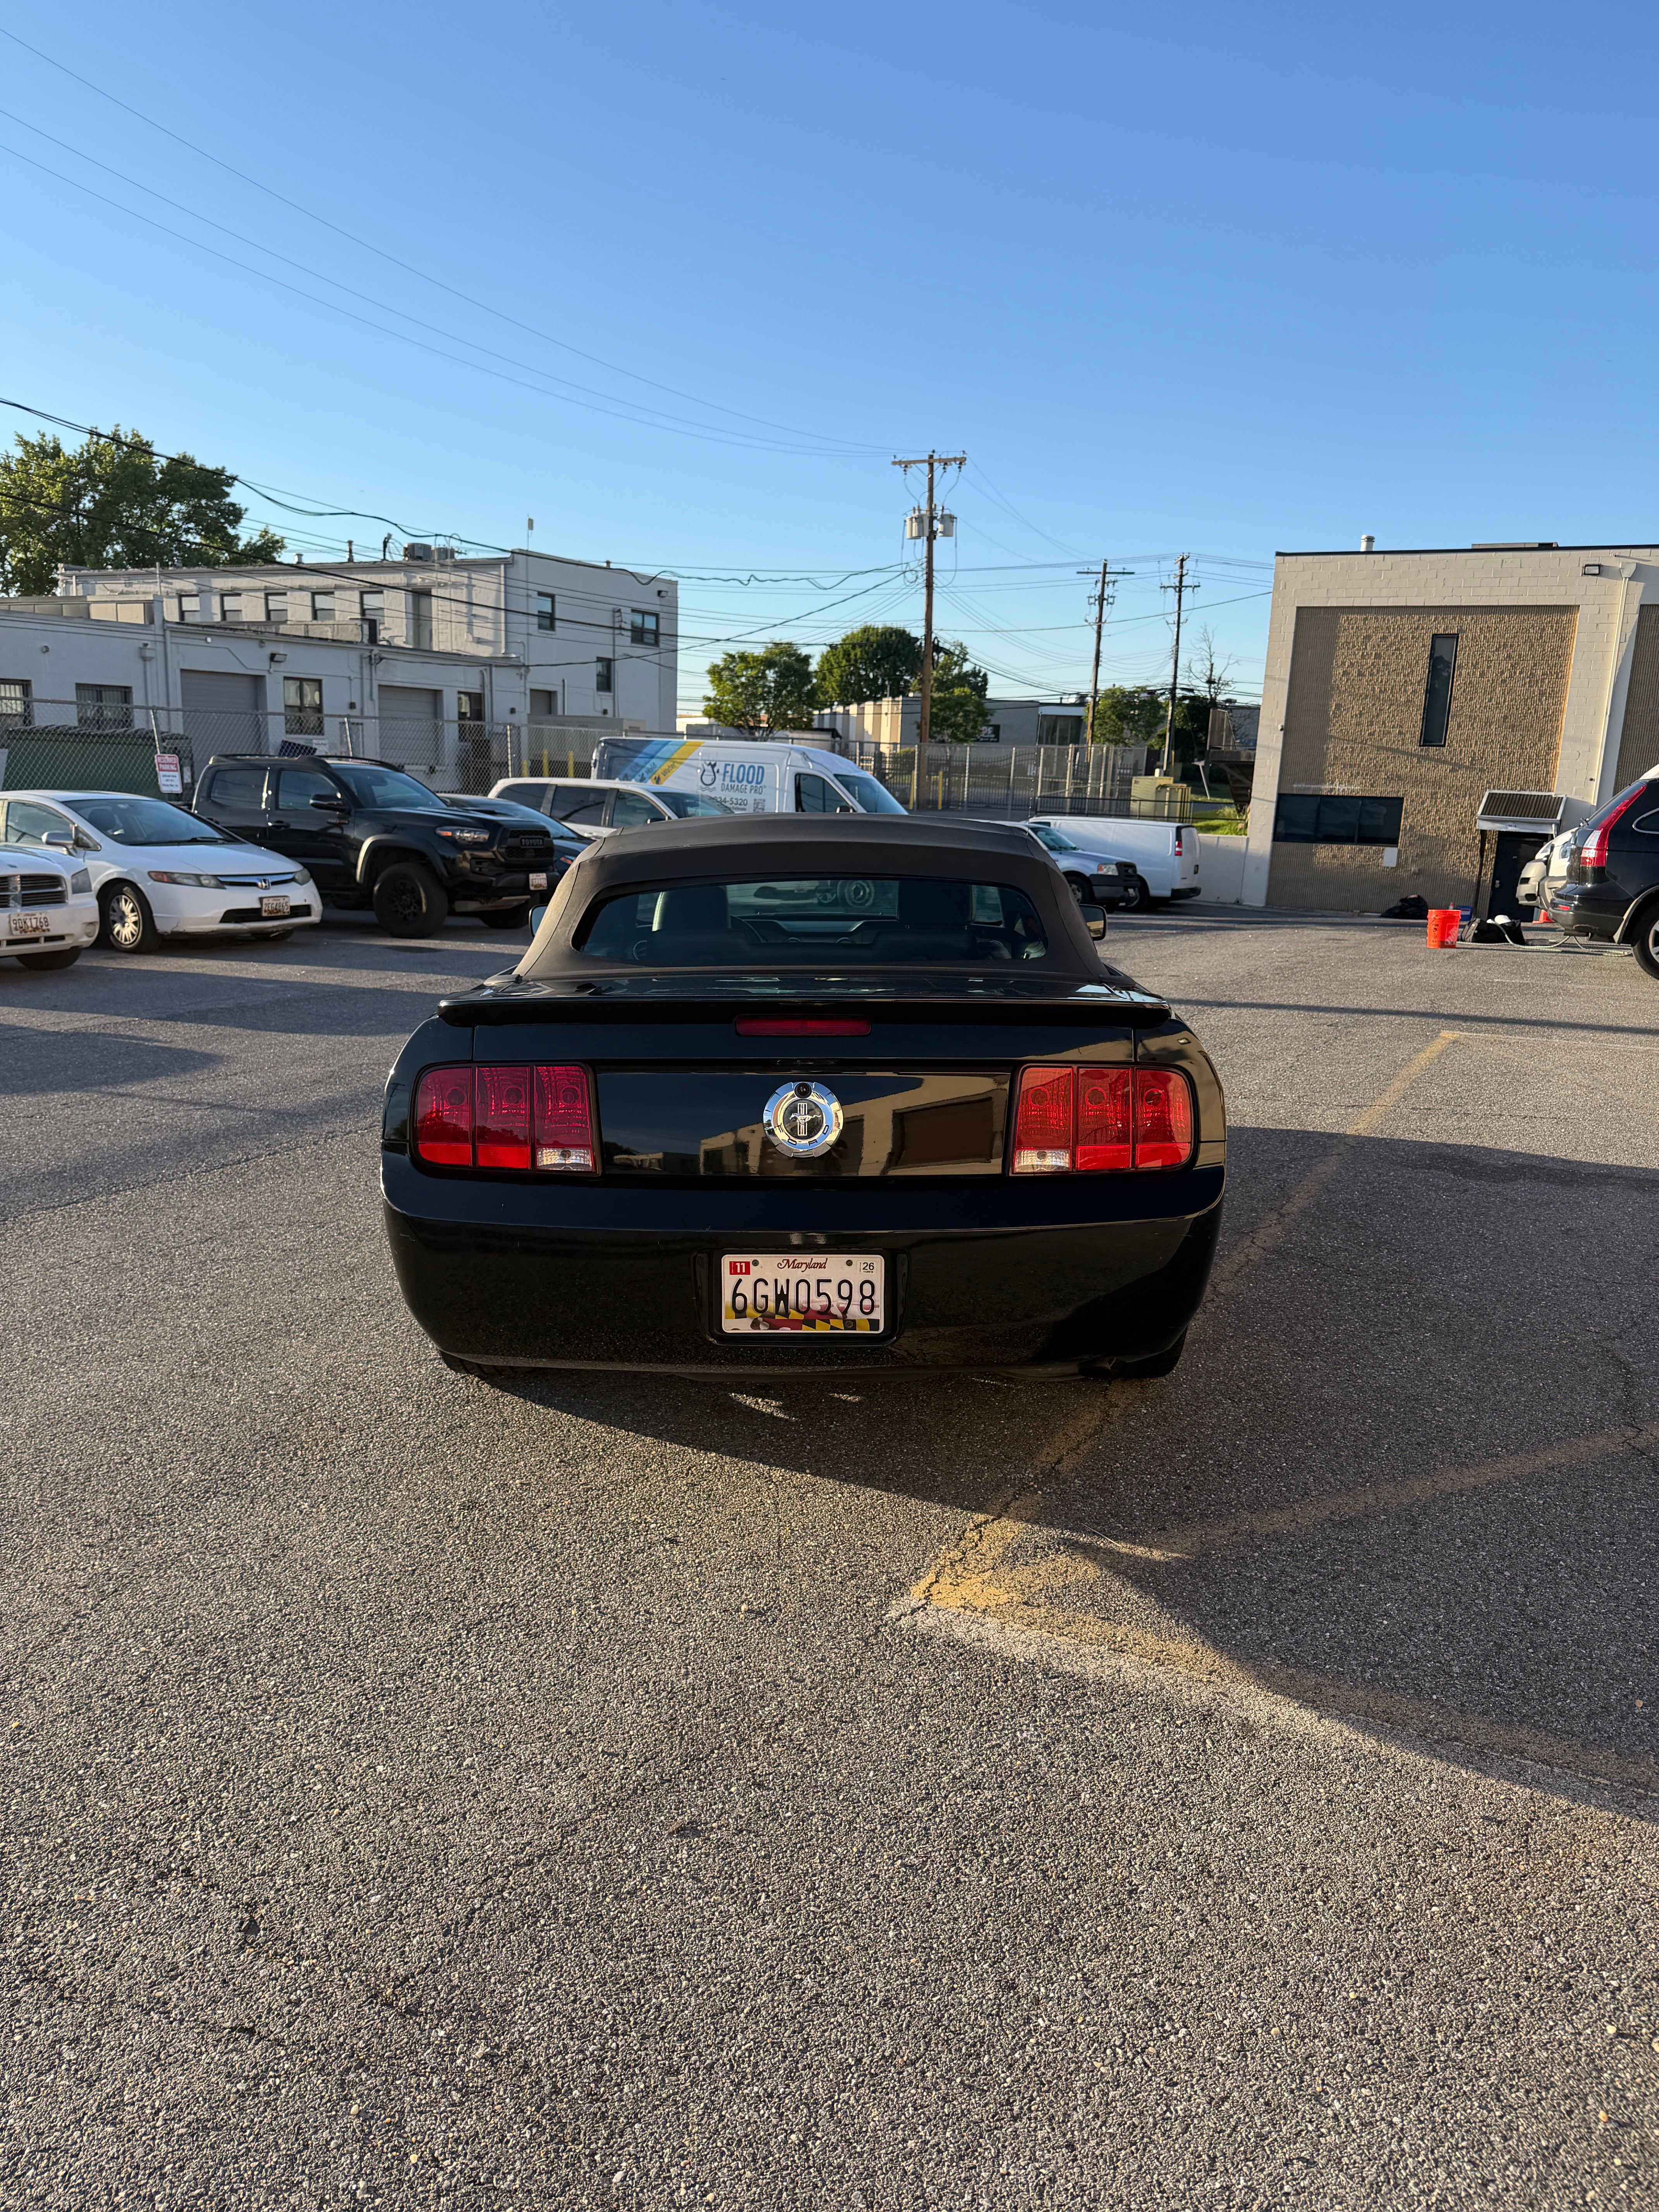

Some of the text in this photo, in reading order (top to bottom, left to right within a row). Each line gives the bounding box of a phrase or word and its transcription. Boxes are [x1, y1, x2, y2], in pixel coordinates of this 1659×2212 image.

[661, 761, 676, 776] Water
[722, 763, 765, 785] FLOOD
[721, 783, 747, 794] DAMAGE
[735, 1262, 745, 1273] 11
[777, 1258, 827, 1272] Maryland
[862, 1262, 874, 1270] 26
[731, 1278, 875, 1316] 6GW0598
